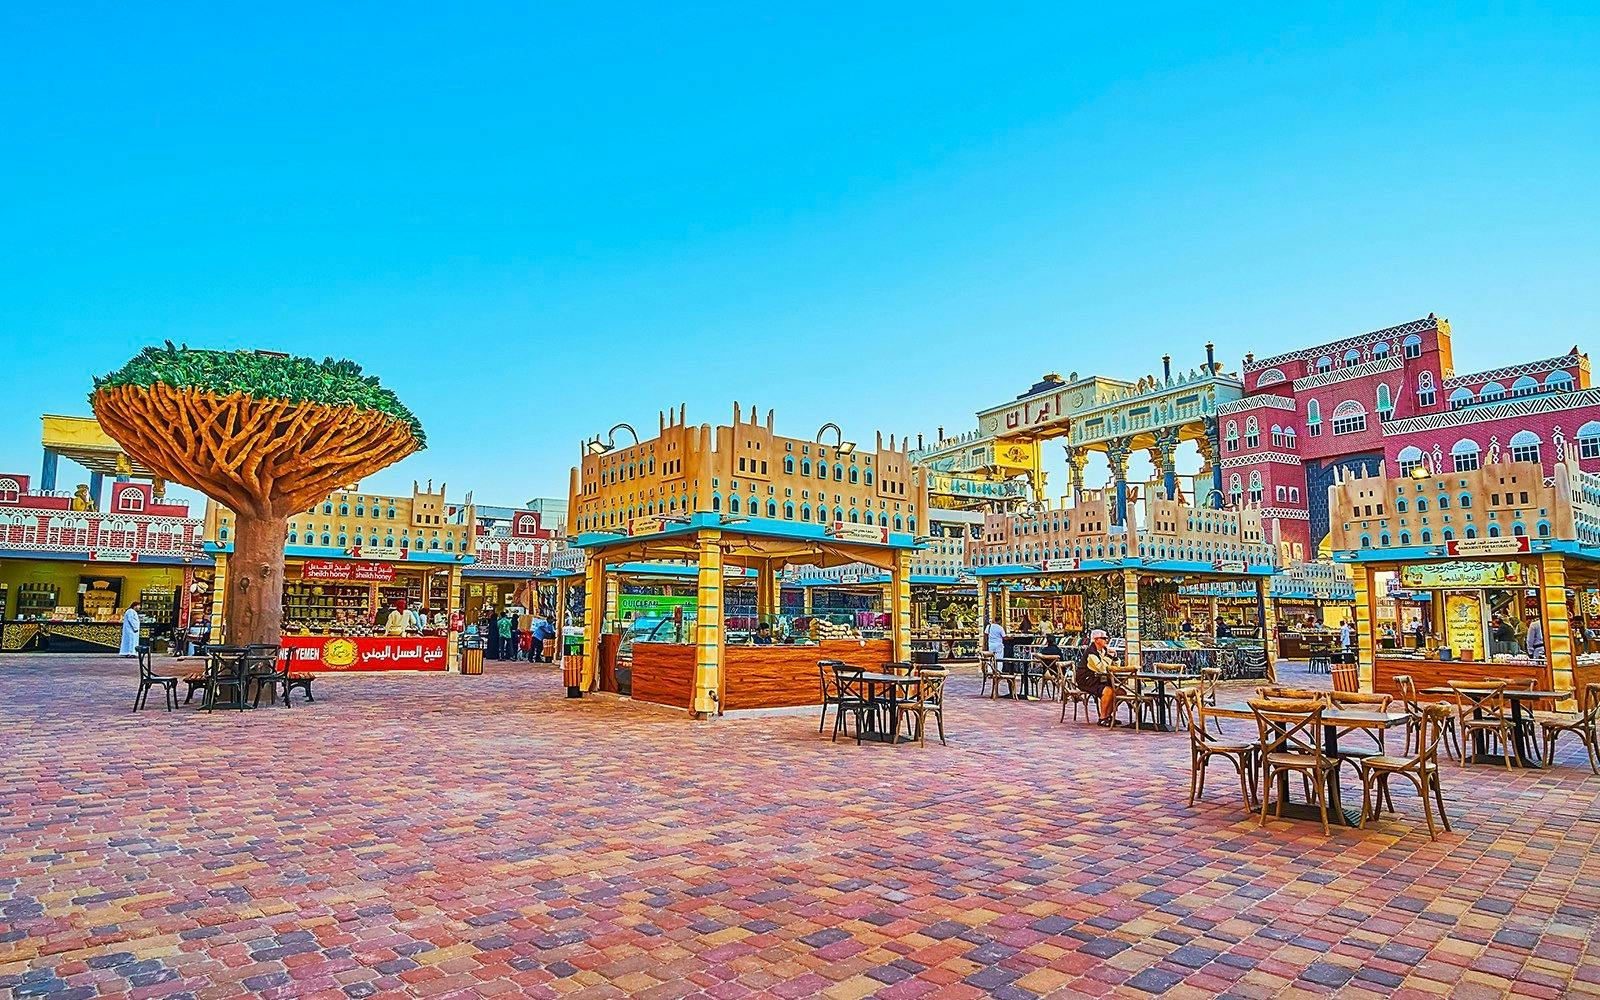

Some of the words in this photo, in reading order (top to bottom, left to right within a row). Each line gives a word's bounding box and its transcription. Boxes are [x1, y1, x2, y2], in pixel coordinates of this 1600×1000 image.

[330, 570, 350, 578] honey
[375, 572, 392, 581] honey
[296, 648, 320, 660] YEMEN
[362, 645, 391, 662] اليمني
[392, 645, 422, 661] العسل
[424, 646, 443, 663] شيخ
